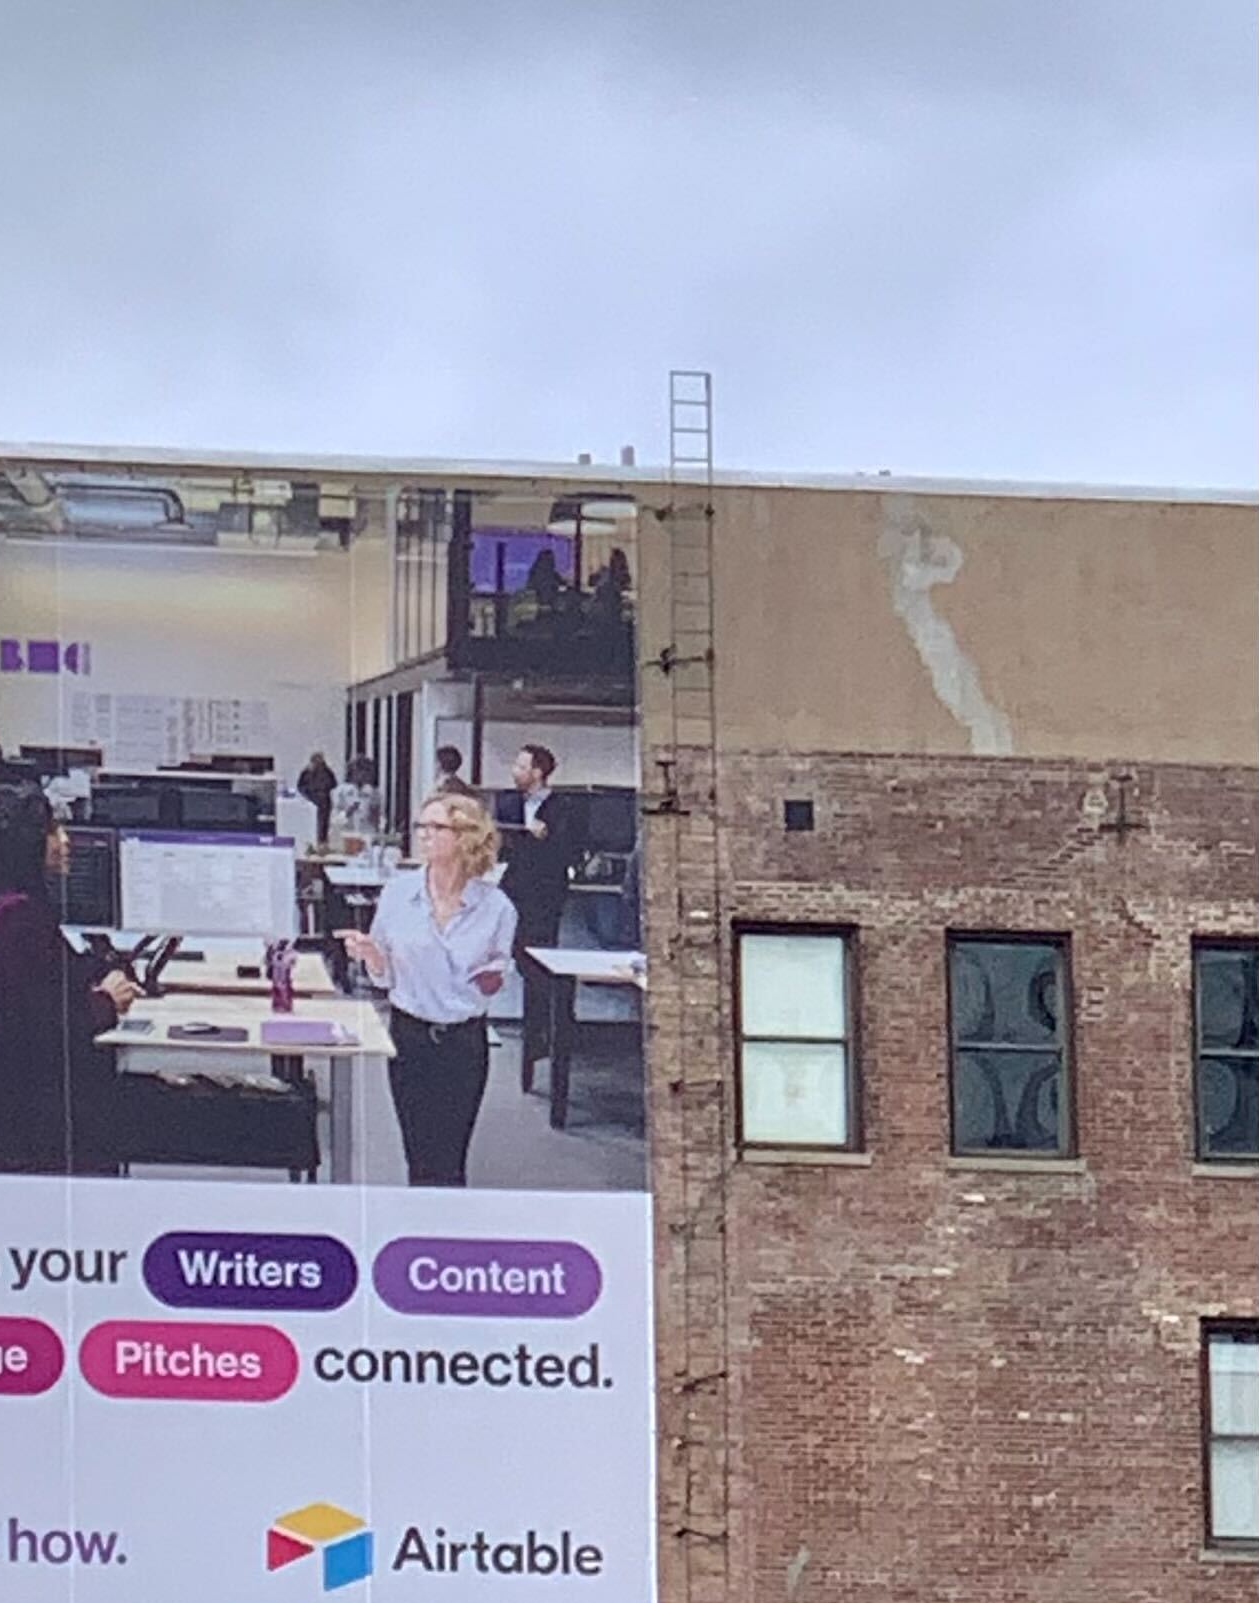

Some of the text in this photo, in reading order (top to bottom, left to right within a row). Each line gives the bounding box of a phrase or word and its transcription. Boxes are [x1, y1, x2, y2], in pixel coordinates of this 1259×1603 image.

[8, 1247, 128, 1291] your
[177, 1249, 322, 1288] Writers
[409, 1256, 566, 1295] Content
[116, 1340, 262, 1379] Pitches
[313, 1343, 613, 1388] connected.
[8, 1517, 127, 1565] how.
[391, 1526, 604, 1576] Airtable
